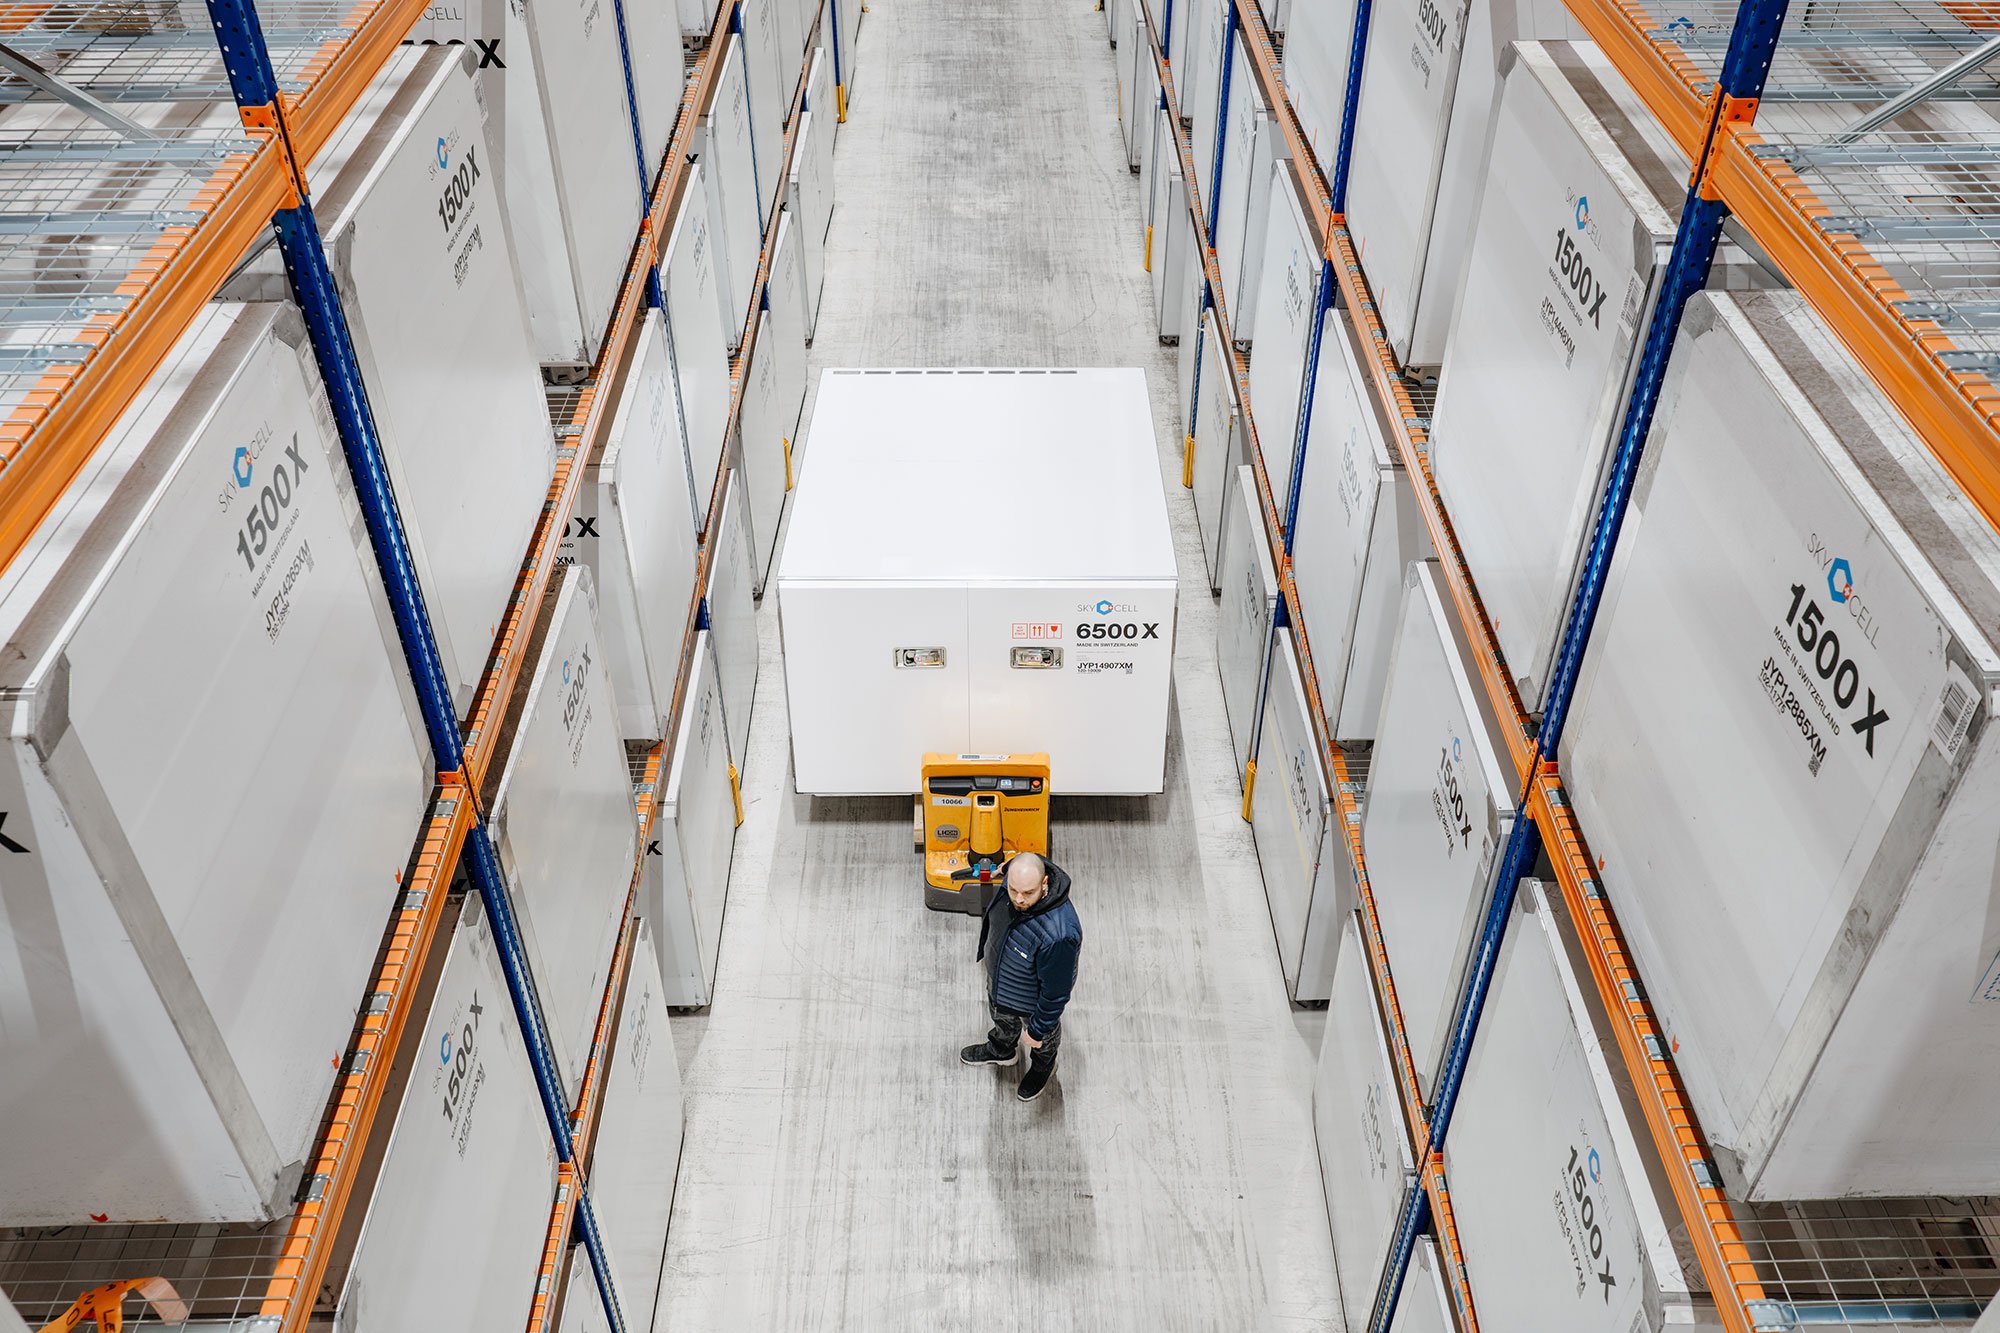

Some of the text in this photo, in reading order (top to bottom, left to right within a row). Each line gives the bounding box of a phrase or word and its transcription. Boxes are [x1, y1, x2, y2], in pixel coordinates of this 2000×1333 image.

[423, 7, 463, 20] CELL
[473, 38, 507, 68] X
[1436, 18, 1447, 54] X
[439, 143, 481, 233] 1500 X
[1555, 227, 1608, 331] 1500 X
[218, 420, 273, 513] SKY CELL
[236, 430, 309, 573] 1500 X
[252, 571, 267, 599] MADE
[270, 508, 300, 564] SWITZERLAND
[574, 517, 600, 537] X
[1076, 623, 1160, 639] 6500 X
[1077, 604, 1139, 613] SKY CELL
[1807, 533, 1879, 650] SKY CELL
[563, 664, 585, 732] 1500
[582, 642, 592, 676] X
[1763, 657, 1827, 763] JYP12885XM
[1773, 625, 1841, 736] MADE IN SWITZERLAND
[1785, 583, 1890, 759] 1500 X
[1440, 747, 1464, 822] 1500
[1460, 811, 1473, 851] X
[443, 1023, 473, 1122] 1500
[469, 988, 483, 1032] X
[1567, 1145, 1617, 1307] 1500 X
